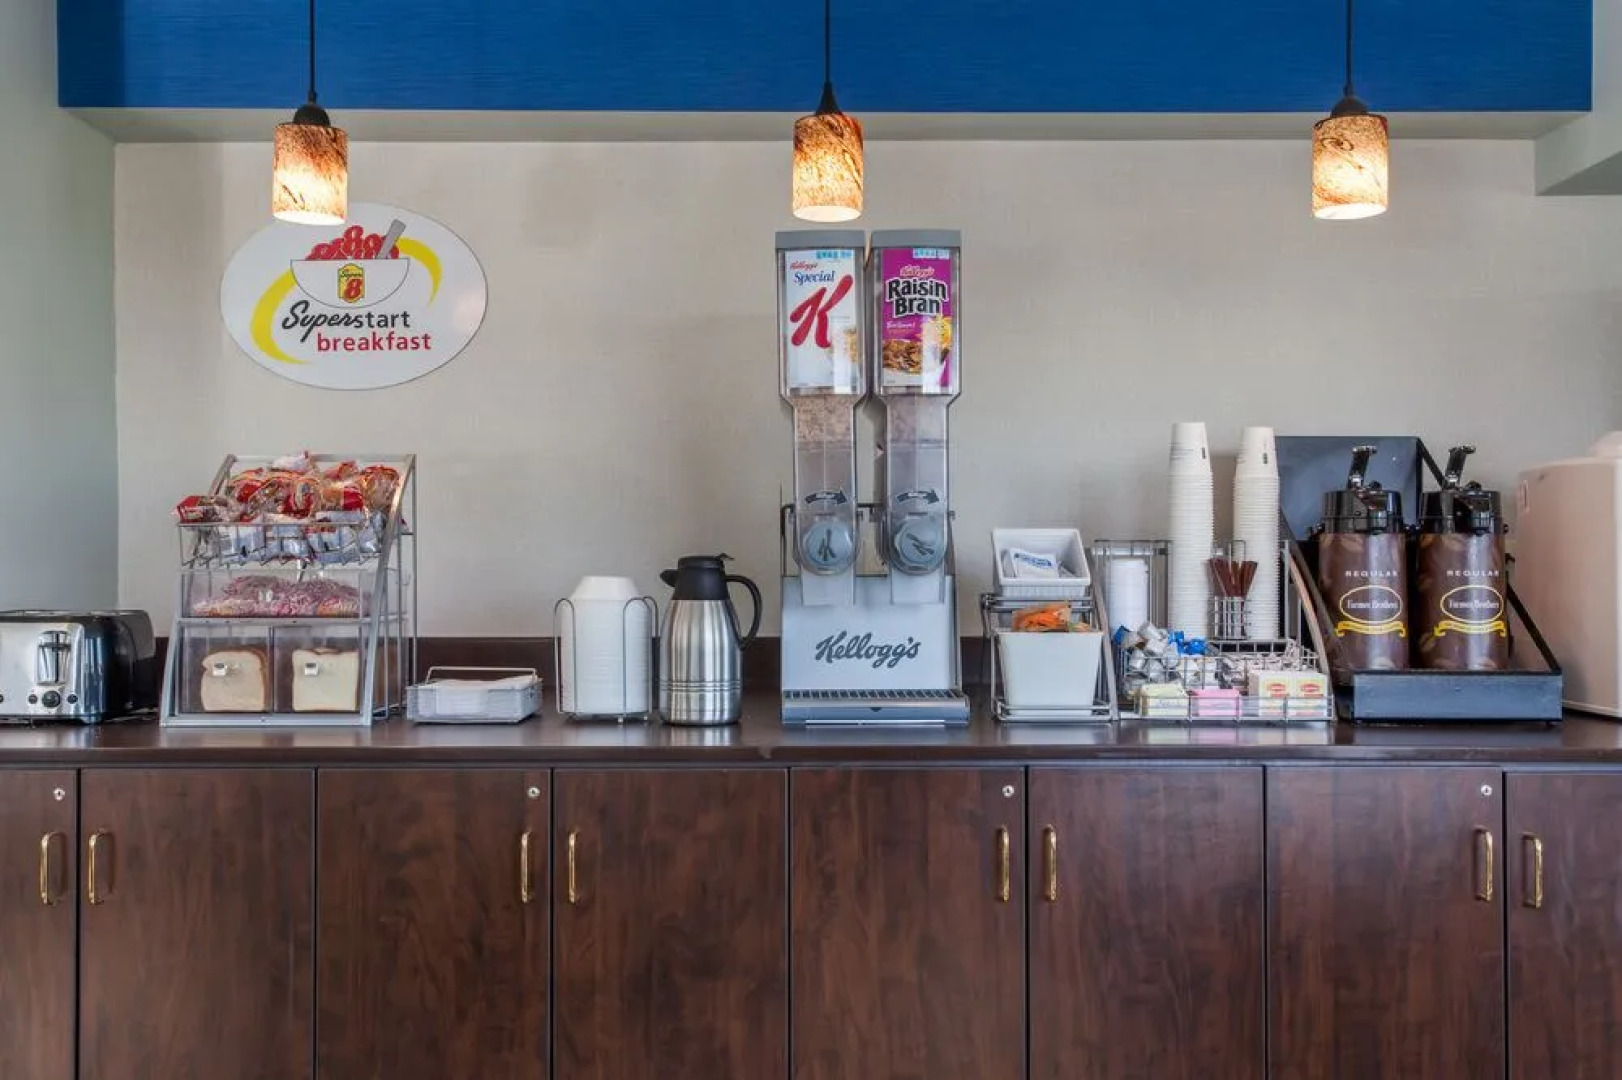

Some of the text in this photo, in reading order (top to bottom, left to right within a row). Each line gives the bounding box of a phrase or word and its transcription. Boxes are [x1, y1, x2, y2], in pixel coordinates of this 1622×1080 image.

[344, 277, 363, 300] 8
[793, 271, 835, 286] Special
[887, 279, 948, 300] Raisin
[790, 274, 854, 349] K
[894, 298, 942, 316] Bran
[282, 300, 411, 342] Superstart
[317, 331, 431, 352] breakfast
[815, 630, 922, 669] Kellogg's
